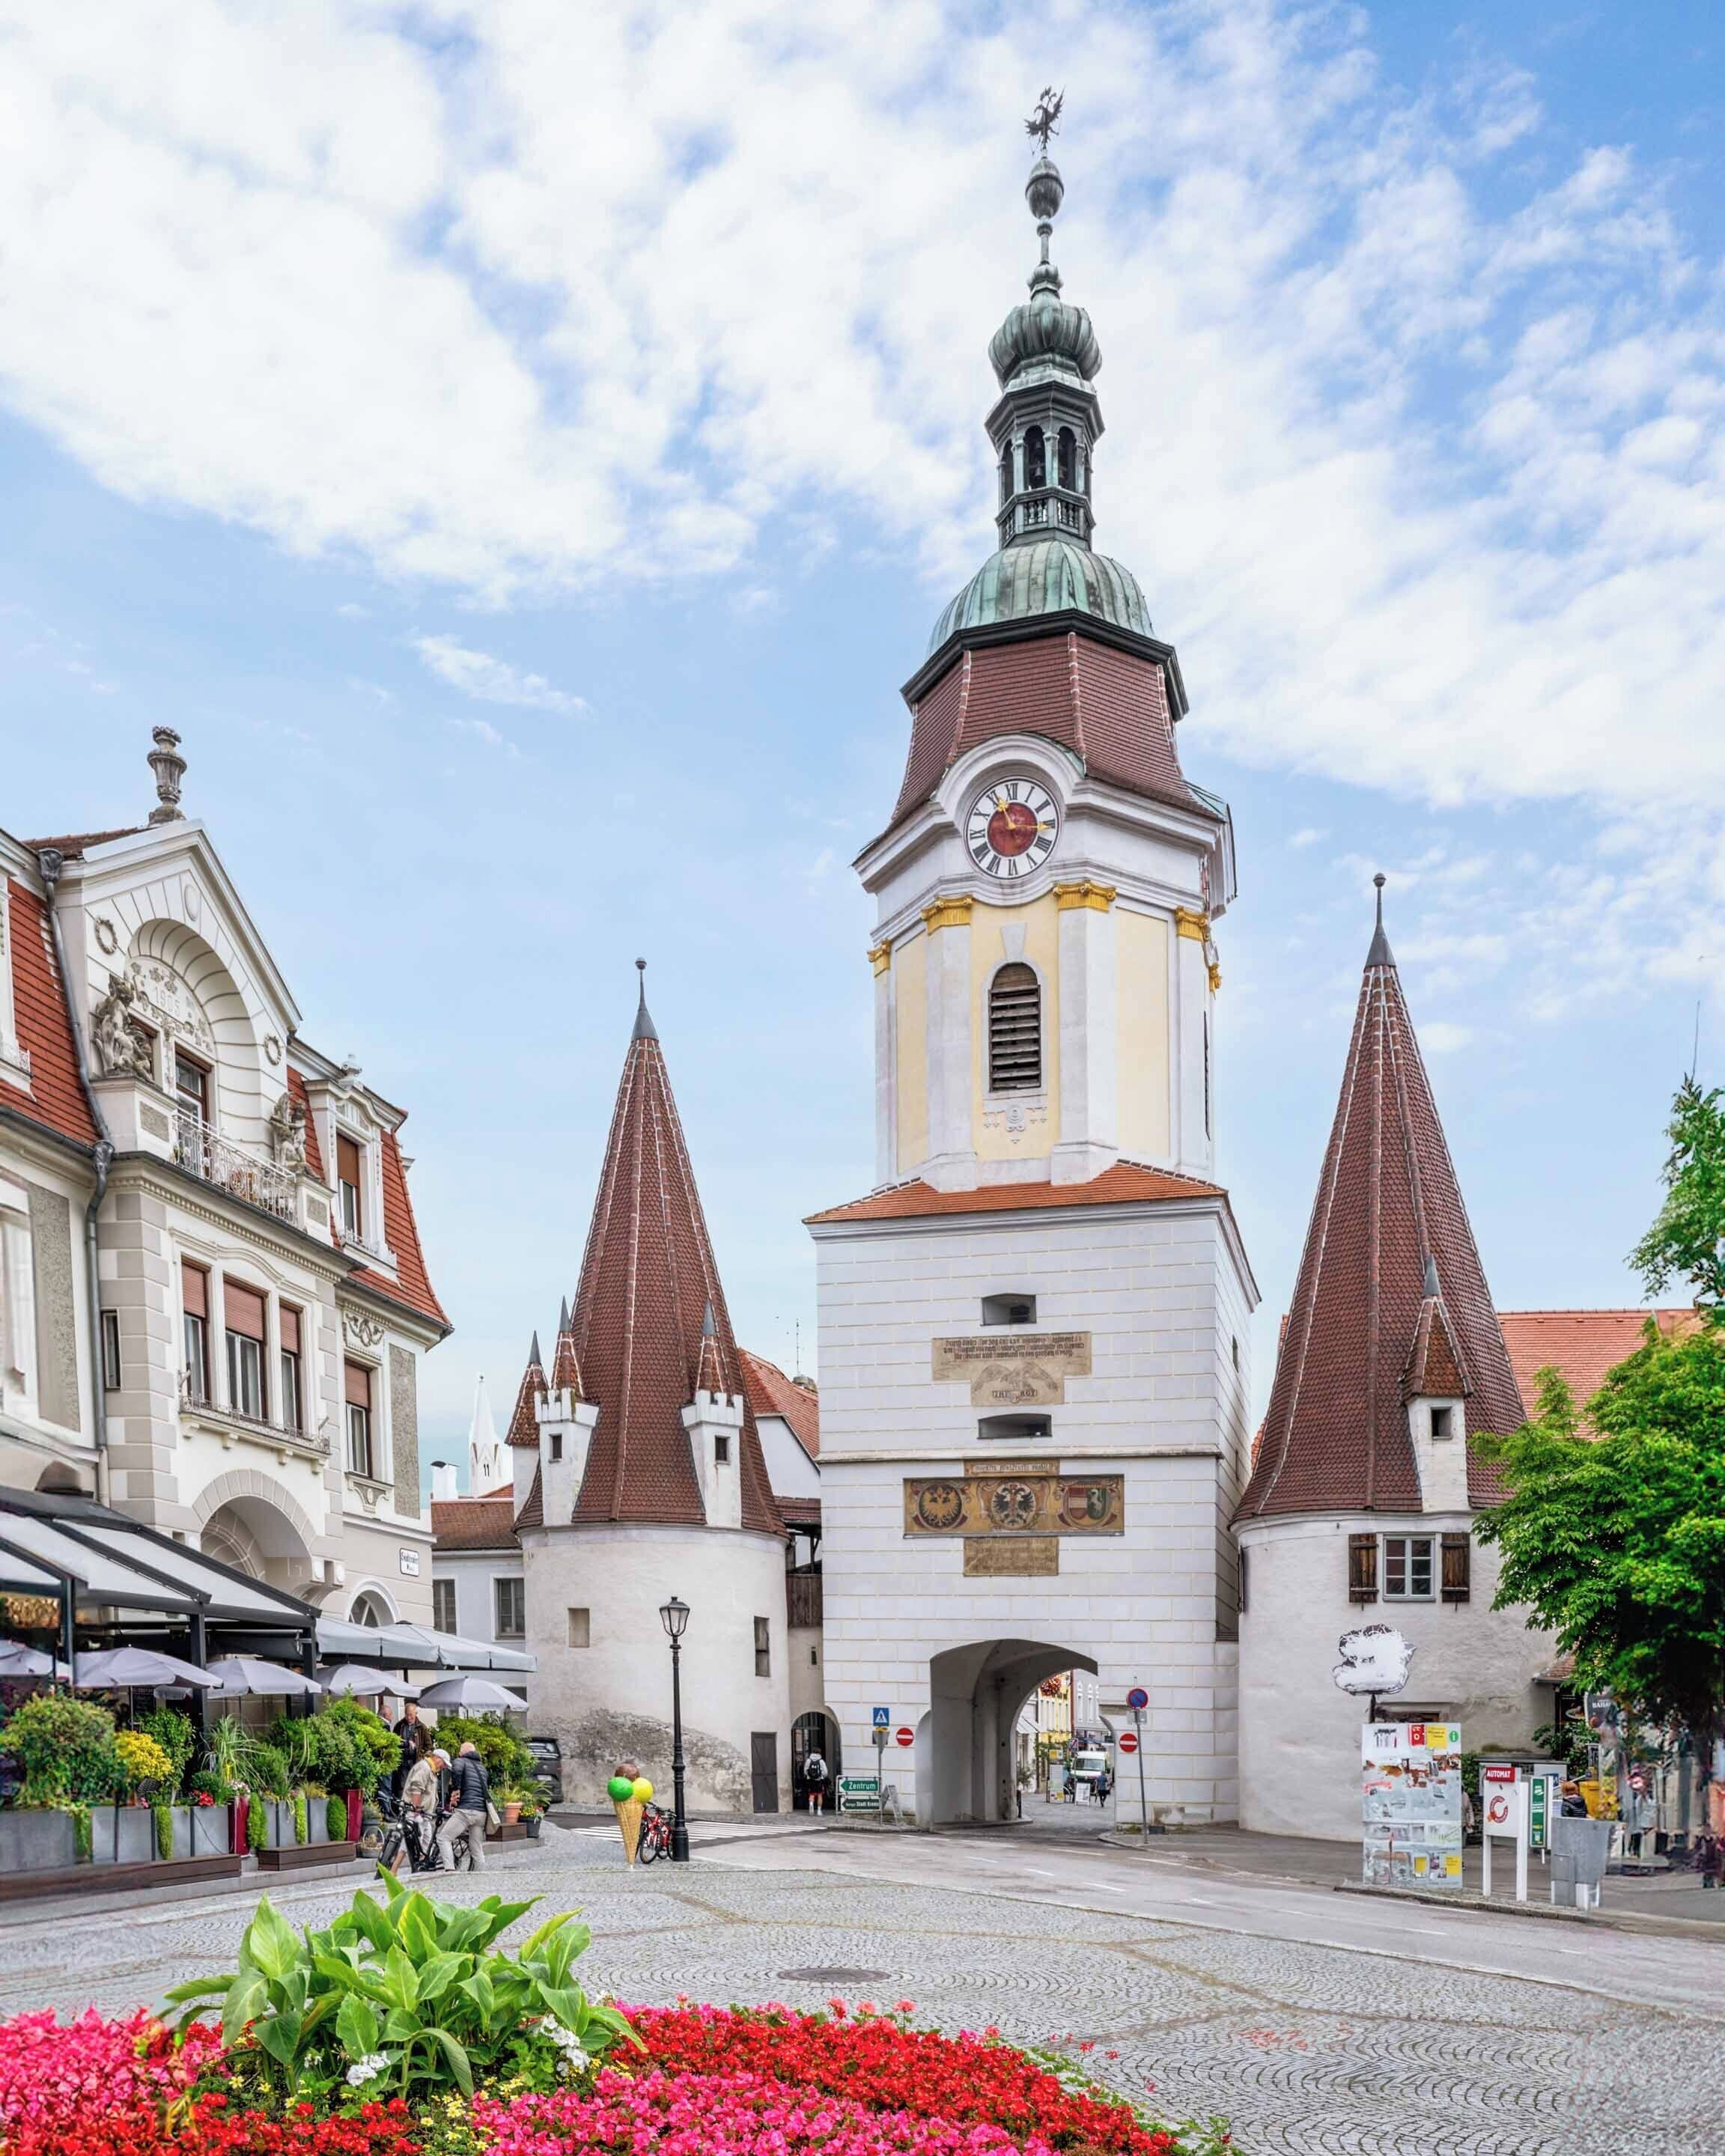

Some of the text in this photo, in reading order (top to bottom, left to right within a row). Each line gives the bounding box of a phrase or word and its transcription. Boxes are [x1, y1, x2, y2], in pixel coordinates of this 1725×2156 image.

[985, 789, 1001, 809] XI
[1005, 782, 1019, 801] XII
[1024, 785, 1035, 803] I
[973, 807, 991, 820] X
[1034, 798, 1051, 814] II
[970, 828, 986, 840] IX
[972, 841, 992, 864] VIII
[1025, 852, 1038, 869] V
[985, 853, 1002, 875] VII
[1007, 858, 1019, 877] VI
[1486, 1770, 1512, 1779] AUTOMAT
[849, 1782, 876, 1790] Zentrum
